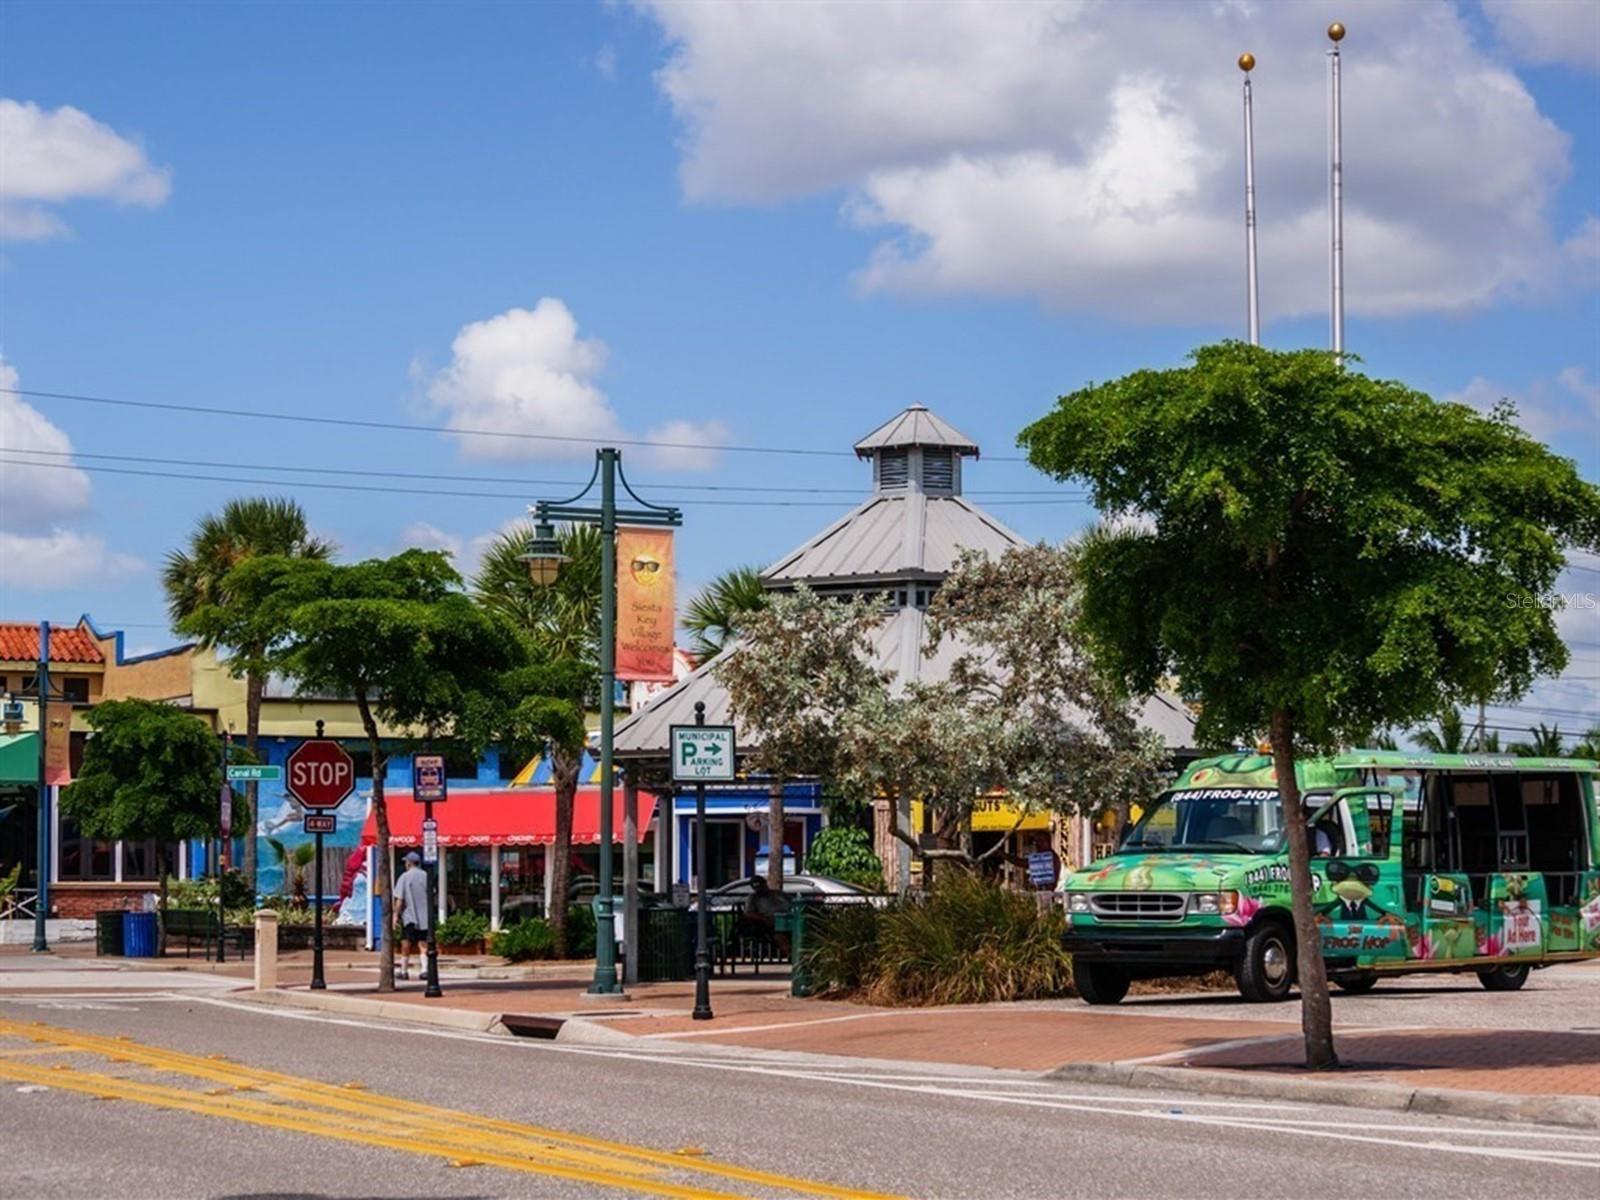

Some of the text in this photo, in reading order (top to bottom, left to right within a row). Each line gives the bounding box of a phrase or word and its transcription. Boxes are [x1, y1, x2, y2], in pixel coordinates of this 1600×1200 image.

[636, 614, 657, 628] Key
[630, 626, 662, 641] Village
[678, 732, 727, 741] MUNICIPAL
[229, 768, 262, 778] Canal Rd
[293, 761, 349, 787] STOP
[695, 766, 712, 776] LOT
[1203, 789, 1279, 800] FROG-HOP
[309, 820, 332, 830] 4-WAY
[1322, 936, 1361, 949] FROG
[1362, 935, 1391, 950] HOP
